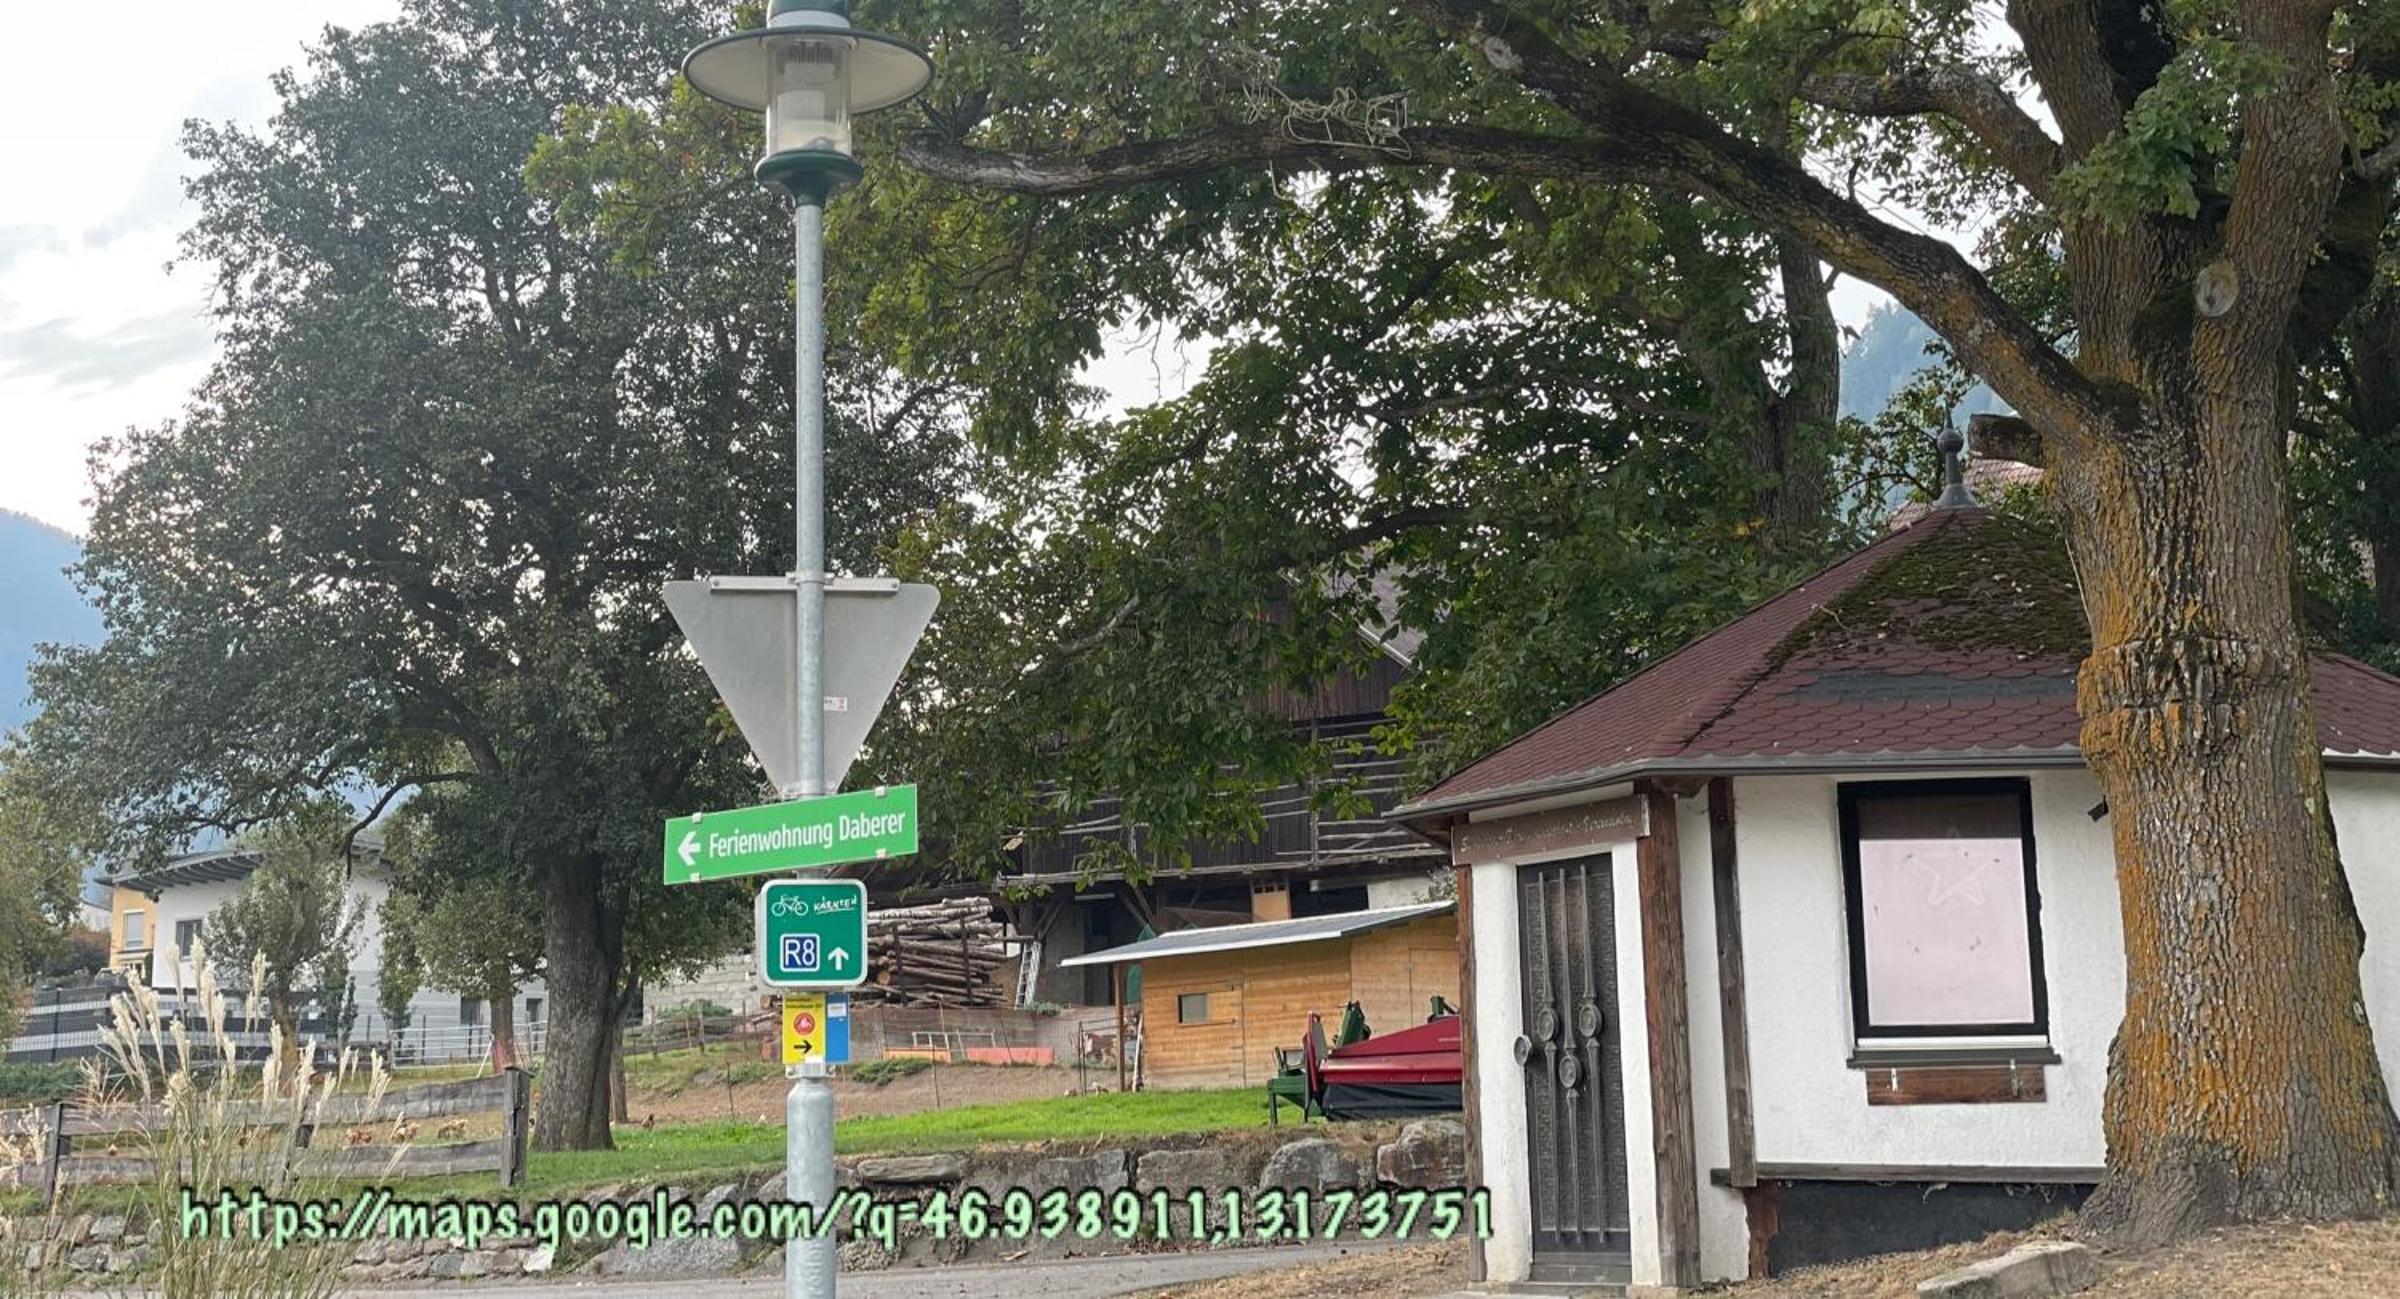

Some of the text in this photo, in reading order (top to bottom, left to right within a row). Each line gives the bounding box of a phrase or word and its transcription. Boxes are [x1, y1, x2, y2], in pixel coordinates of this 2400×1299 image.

[709, 812, 906, 858] Ferienwohnung Daberer
[784, 938, 816, 967] R8
